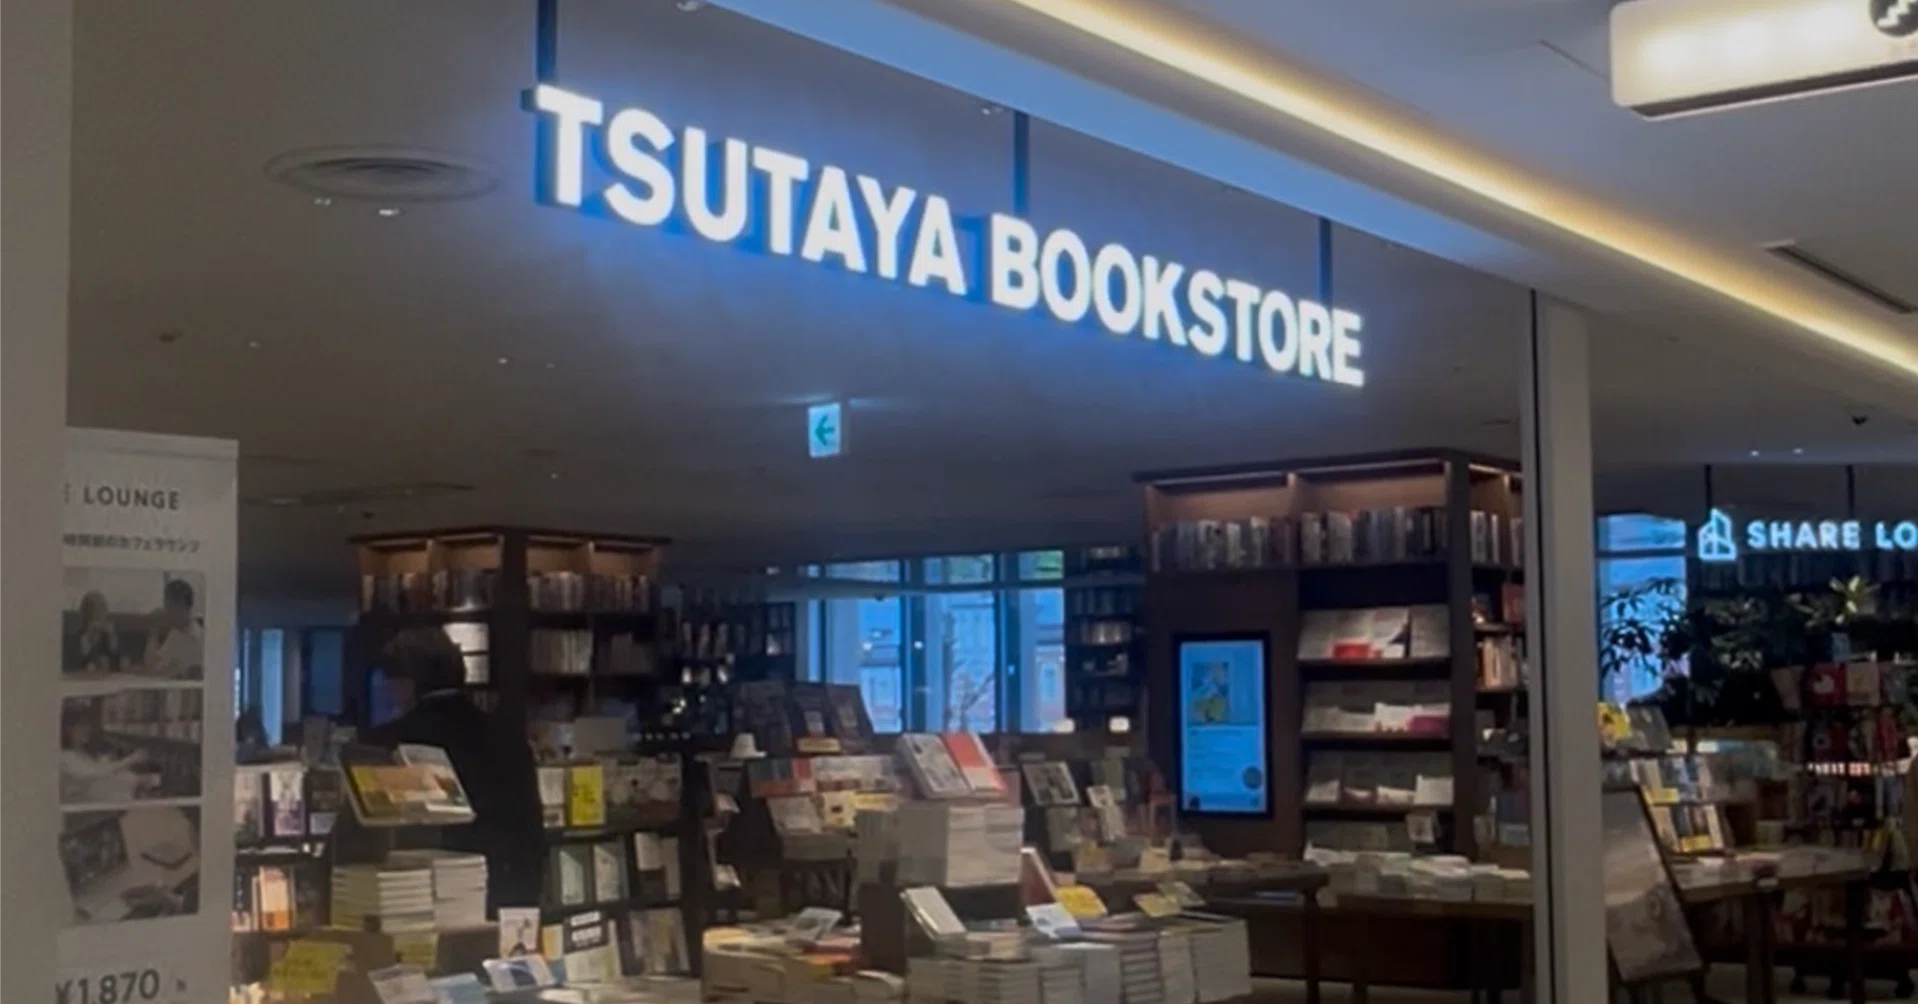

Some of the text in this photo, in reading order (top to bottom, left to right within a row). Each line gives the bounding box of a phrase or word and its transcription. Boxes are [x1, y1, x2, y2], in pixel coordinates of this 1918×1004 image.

[536, 84, 1365, 388] TSUTAYA BOOKSTORE
[83, 485, 181, 511] LOUNGE
[1747, 520, 1918, 549] SHARE LO
